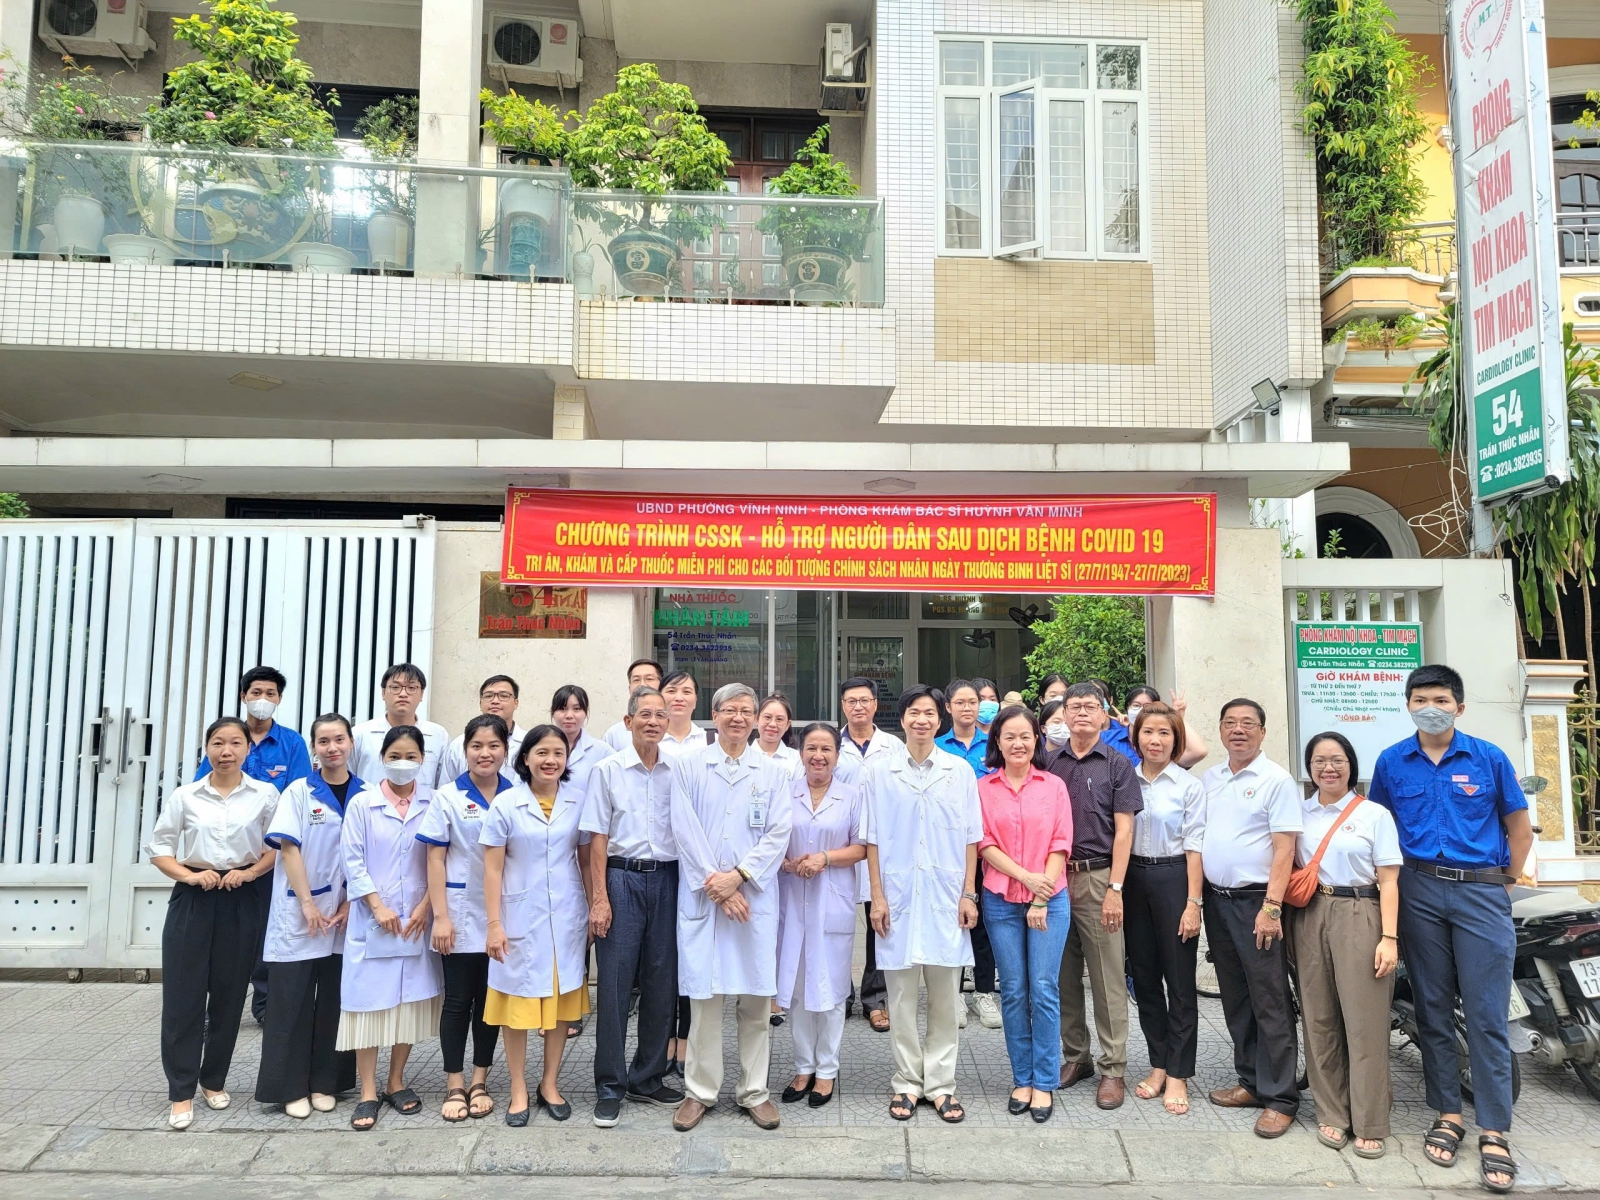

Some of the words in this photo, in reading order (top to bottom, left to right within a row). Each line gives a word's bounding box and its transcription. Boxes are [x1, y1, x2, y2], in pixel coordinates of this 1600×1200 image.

[1494, 23, 1507, 49] CLINIC
[1472, 78, 1512, 150] PHÒNG
[1477, 145, 1513, 216] KHÁM
[1472, 224, 1493, 292] NỘI
[1494, 211, 1528, 274] KHOA
[1474, 300, 1496, 354] TIM
[1497, 279, 1534, 347] MẠCH
[1476, 356, 1513, 386] CARDIOLOGY
[1514, 345, 1536, 368] CLINIC
[1492, 388, 1524, 436] 54
[1498, 436, 1517, 454] THÚC
[636, 502, 674, 514] UBND
[678, 502, 735, 514] PHƯỜNG
[740, 503, 770, 514] VĨNH
[775, 505, 807, 515] NINH
[820, 504, 868, 516] PHÒNG
[872, 504, 910, 516] KHÁM
[916, 504, 944, 516] BÁC
[948, 504, 960, 516] SĨ
[964, 505, 1012, 517] HUỲNH
[1016, 505, 1044, 517] VĂN
[1048, 506, 1083, 518] MINH
[556, 520, 630, 546] CHƯƠNG
[636, 518, 690, 547] TRÌNH
[694, 524, 744, 548] CSSK
[762, 516, 786, 548] HỖ
[791, 524, 826, 554] TRỢ
[831, 520, 887, 550] NGƯỜI
[893, 521, 931, 550] DÂN
[936, 527, 972, 551] SAU
[977, 527, 1020, 556] DỊCH
[1026, 522, 1076, 558] BỆNH
[1082, 528, 1136, 553] COVID
[1142, 529, 1164, 554] 19
[526, 554, 542, 572] TRI
[544, 552, 562, 574] ÂN,
[566, 552, 598, 573] KHÁM
[600, 554, 614, 574] VÀ
[616, 551, 638, 574] CẤP
[640, 551, 674, 574] THUỐC
[678, 552, 704, 575] MIỄN
[708, 554, 726, 575] PHÍ
[728, 558, 749, 576] CHO
[752, 555, 773, 576] CÁC
[776, 552, 794, 576] ĐỐI
[796, 558, 830, 580] TƯỢNG
[834, 556, 866, 578] CHÍNH
[868, 557, 896, 578] SÁCH
[900, 557, 930, 578] NHÂN
[932, 558, 960, 578] NGÀY
[963, 560, 1004, 579] THƯƠNG
[1008, 562, 1033, 580] BINH
[1036, 559, 1058, 584] LIỆT
[1060, 560, 1072, 580] SĨ
[1074, 562, 1190, 582] (27/7/1947-27/7/2023)
[511, 585, 554, 606] 54
[669, 590, 694, 602] NHÀ
[696, 590, 736, 603] THUỐC
[486, 613, 513, 630] Trần
[517, 614, 545, 630] Thúc
[654, 606, 706, 626] NHÂN
[710, 606, 750, 628] TÂM
[680, 630, 696, 639] Trần
[1324, 625, 1344, 642] KHÁM
[1345, 626, 1357, 646] NỘI
[1358, 628, 1377, 643] KHOA
[1382, 629, 1395, 643] TIM
[1396, 629, 1417, 646] MẠCH
[1308, 647, 1372, 655] CARDIOLOGY
[1340, 671, 1370, 681] KHÁM
[1374, 671, 1404, 684] BỆNH:
